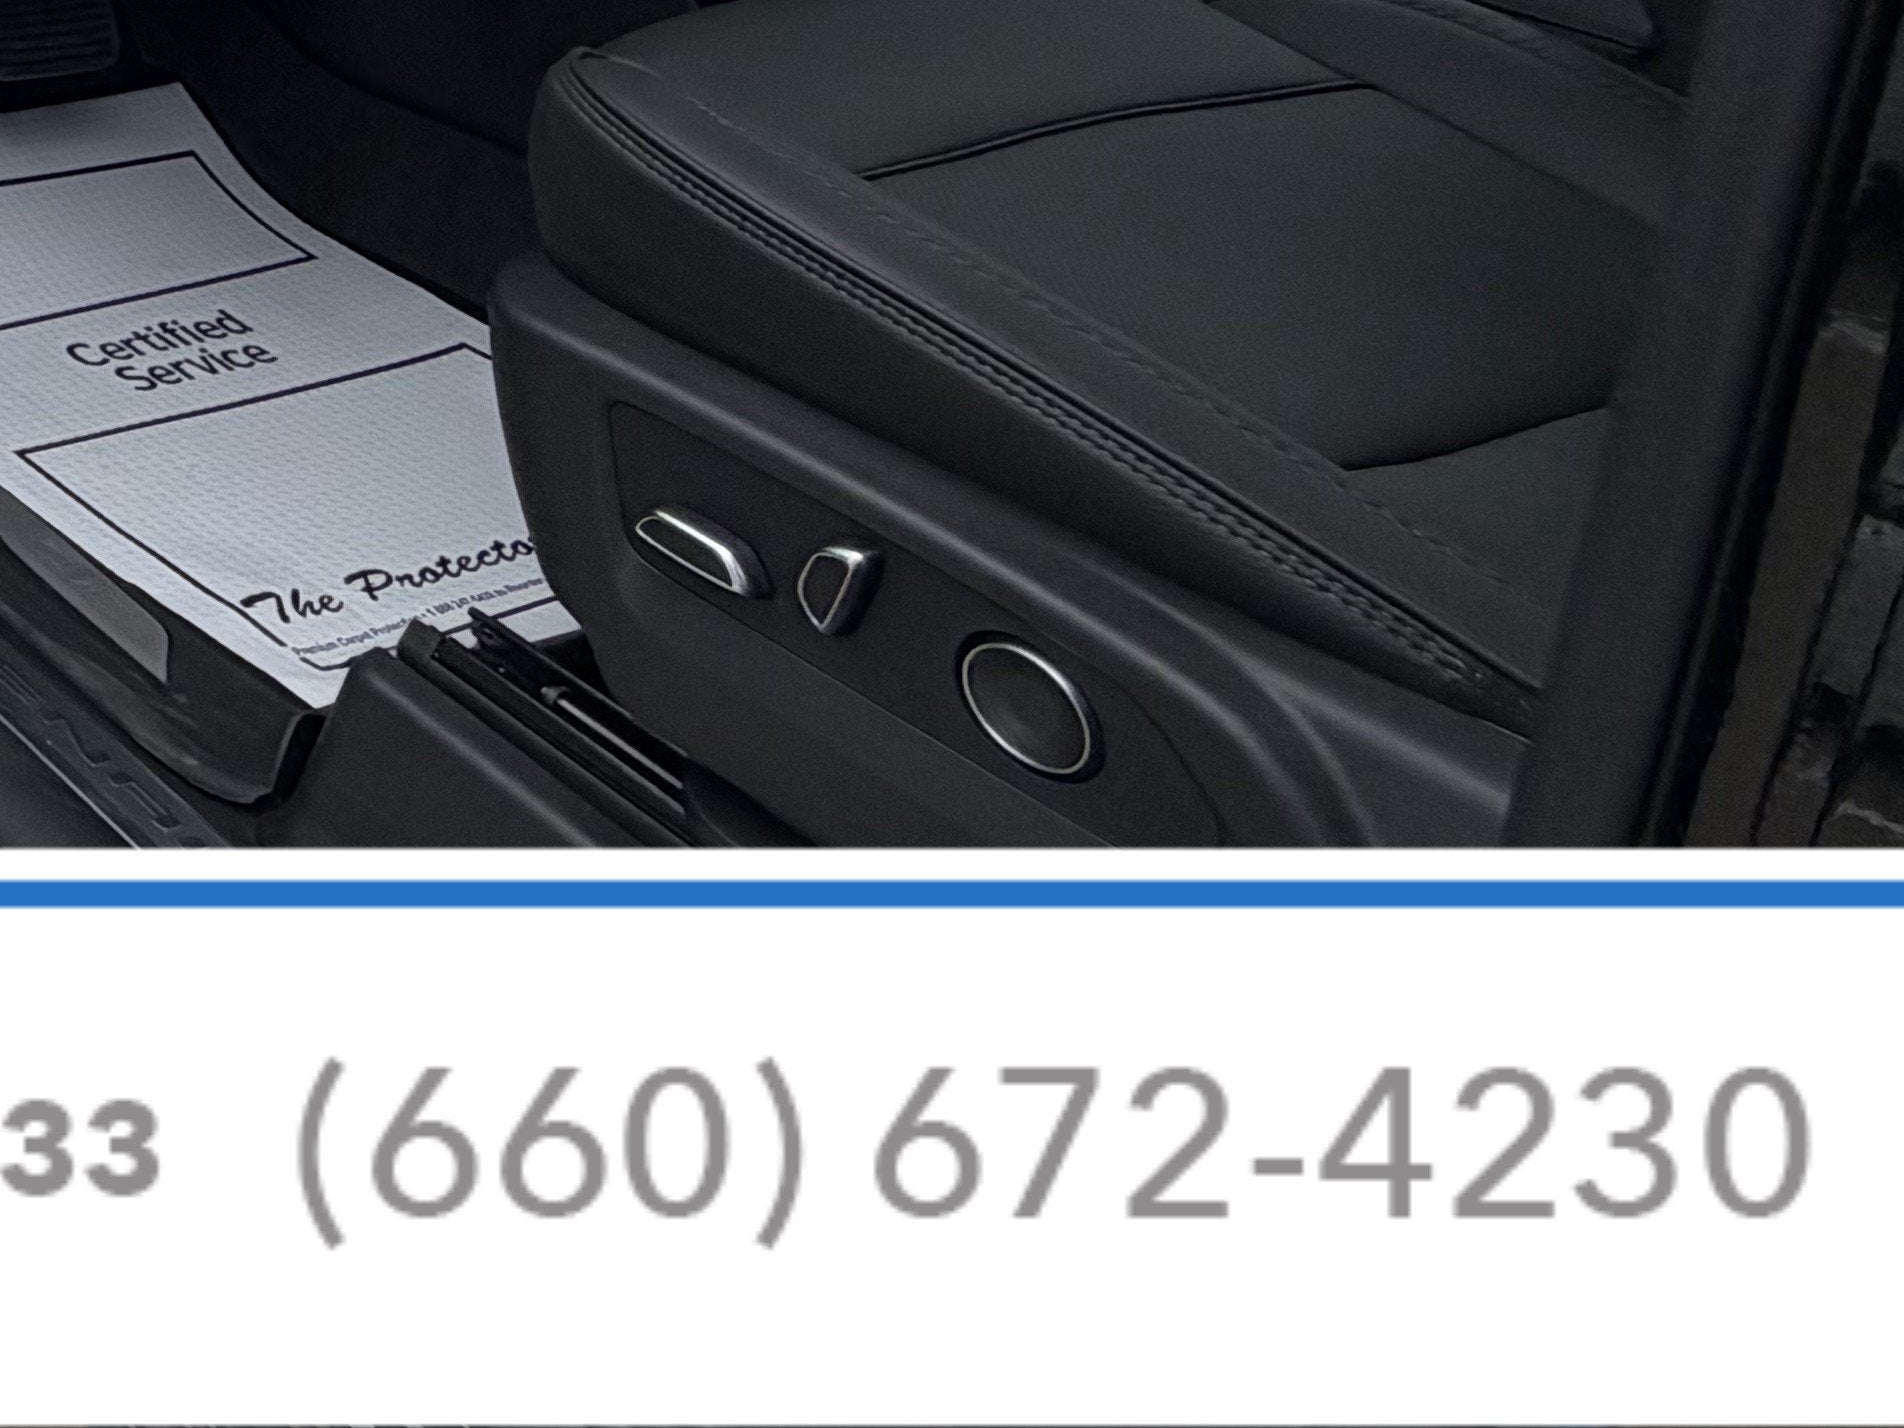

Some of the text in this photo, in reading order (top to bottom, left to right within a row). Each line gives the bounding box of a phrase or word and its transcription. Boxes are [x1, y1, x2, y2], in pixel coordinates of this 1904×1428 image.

[65, 308, 255, 367] Certified
[114, 345, 279, 392] Service
[239, 536, 537, 624] The Protecto
